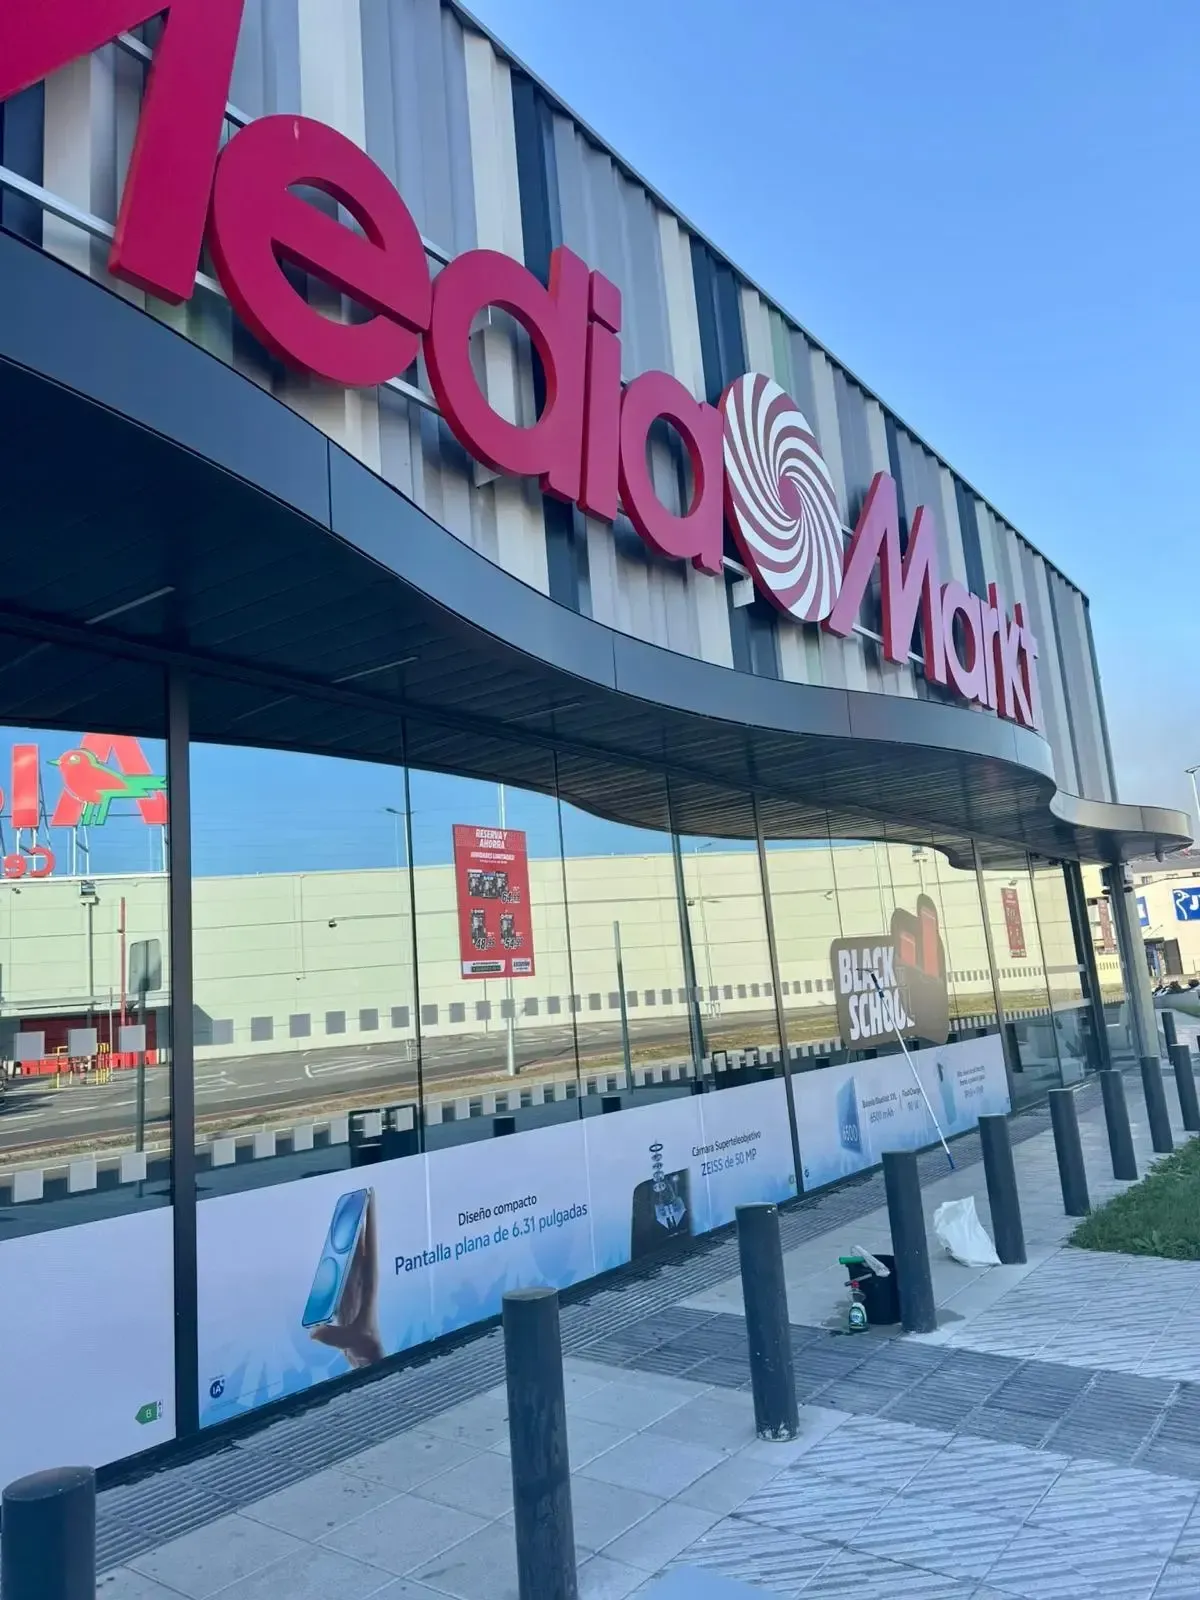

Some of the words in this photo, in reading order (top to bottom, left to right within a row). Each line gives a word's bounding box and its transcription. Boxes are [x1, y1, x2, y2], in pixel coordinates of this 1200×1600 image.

[820, 470, 1040, 733] Markt
[479, 839, 506, 849] AHORRA
[838, 946, 897, 994] BLACK
[691, 1143, 715, 1157] Cámara
[715, 1129, 762, 1152] Superteleobjetivo
[701, 1161, 724, 1176] ZEISS
[724, 1156, 734, 1168] de
[735, 1153, 745, 1166] 50
[745, 1148, 757, 1164] MP
[458, 1206, 492, 1226] Diseño
[493, 1193, 538, 1216] compacto
[395, 1243, 452, 1275] Pantalla
[455, 1233, 491, 1260] plana
[494, 1225, 509, 1243] de
[512, 1215, 536, 1238] 6.31
[538, 1202, 588, 1233] pulgadas
